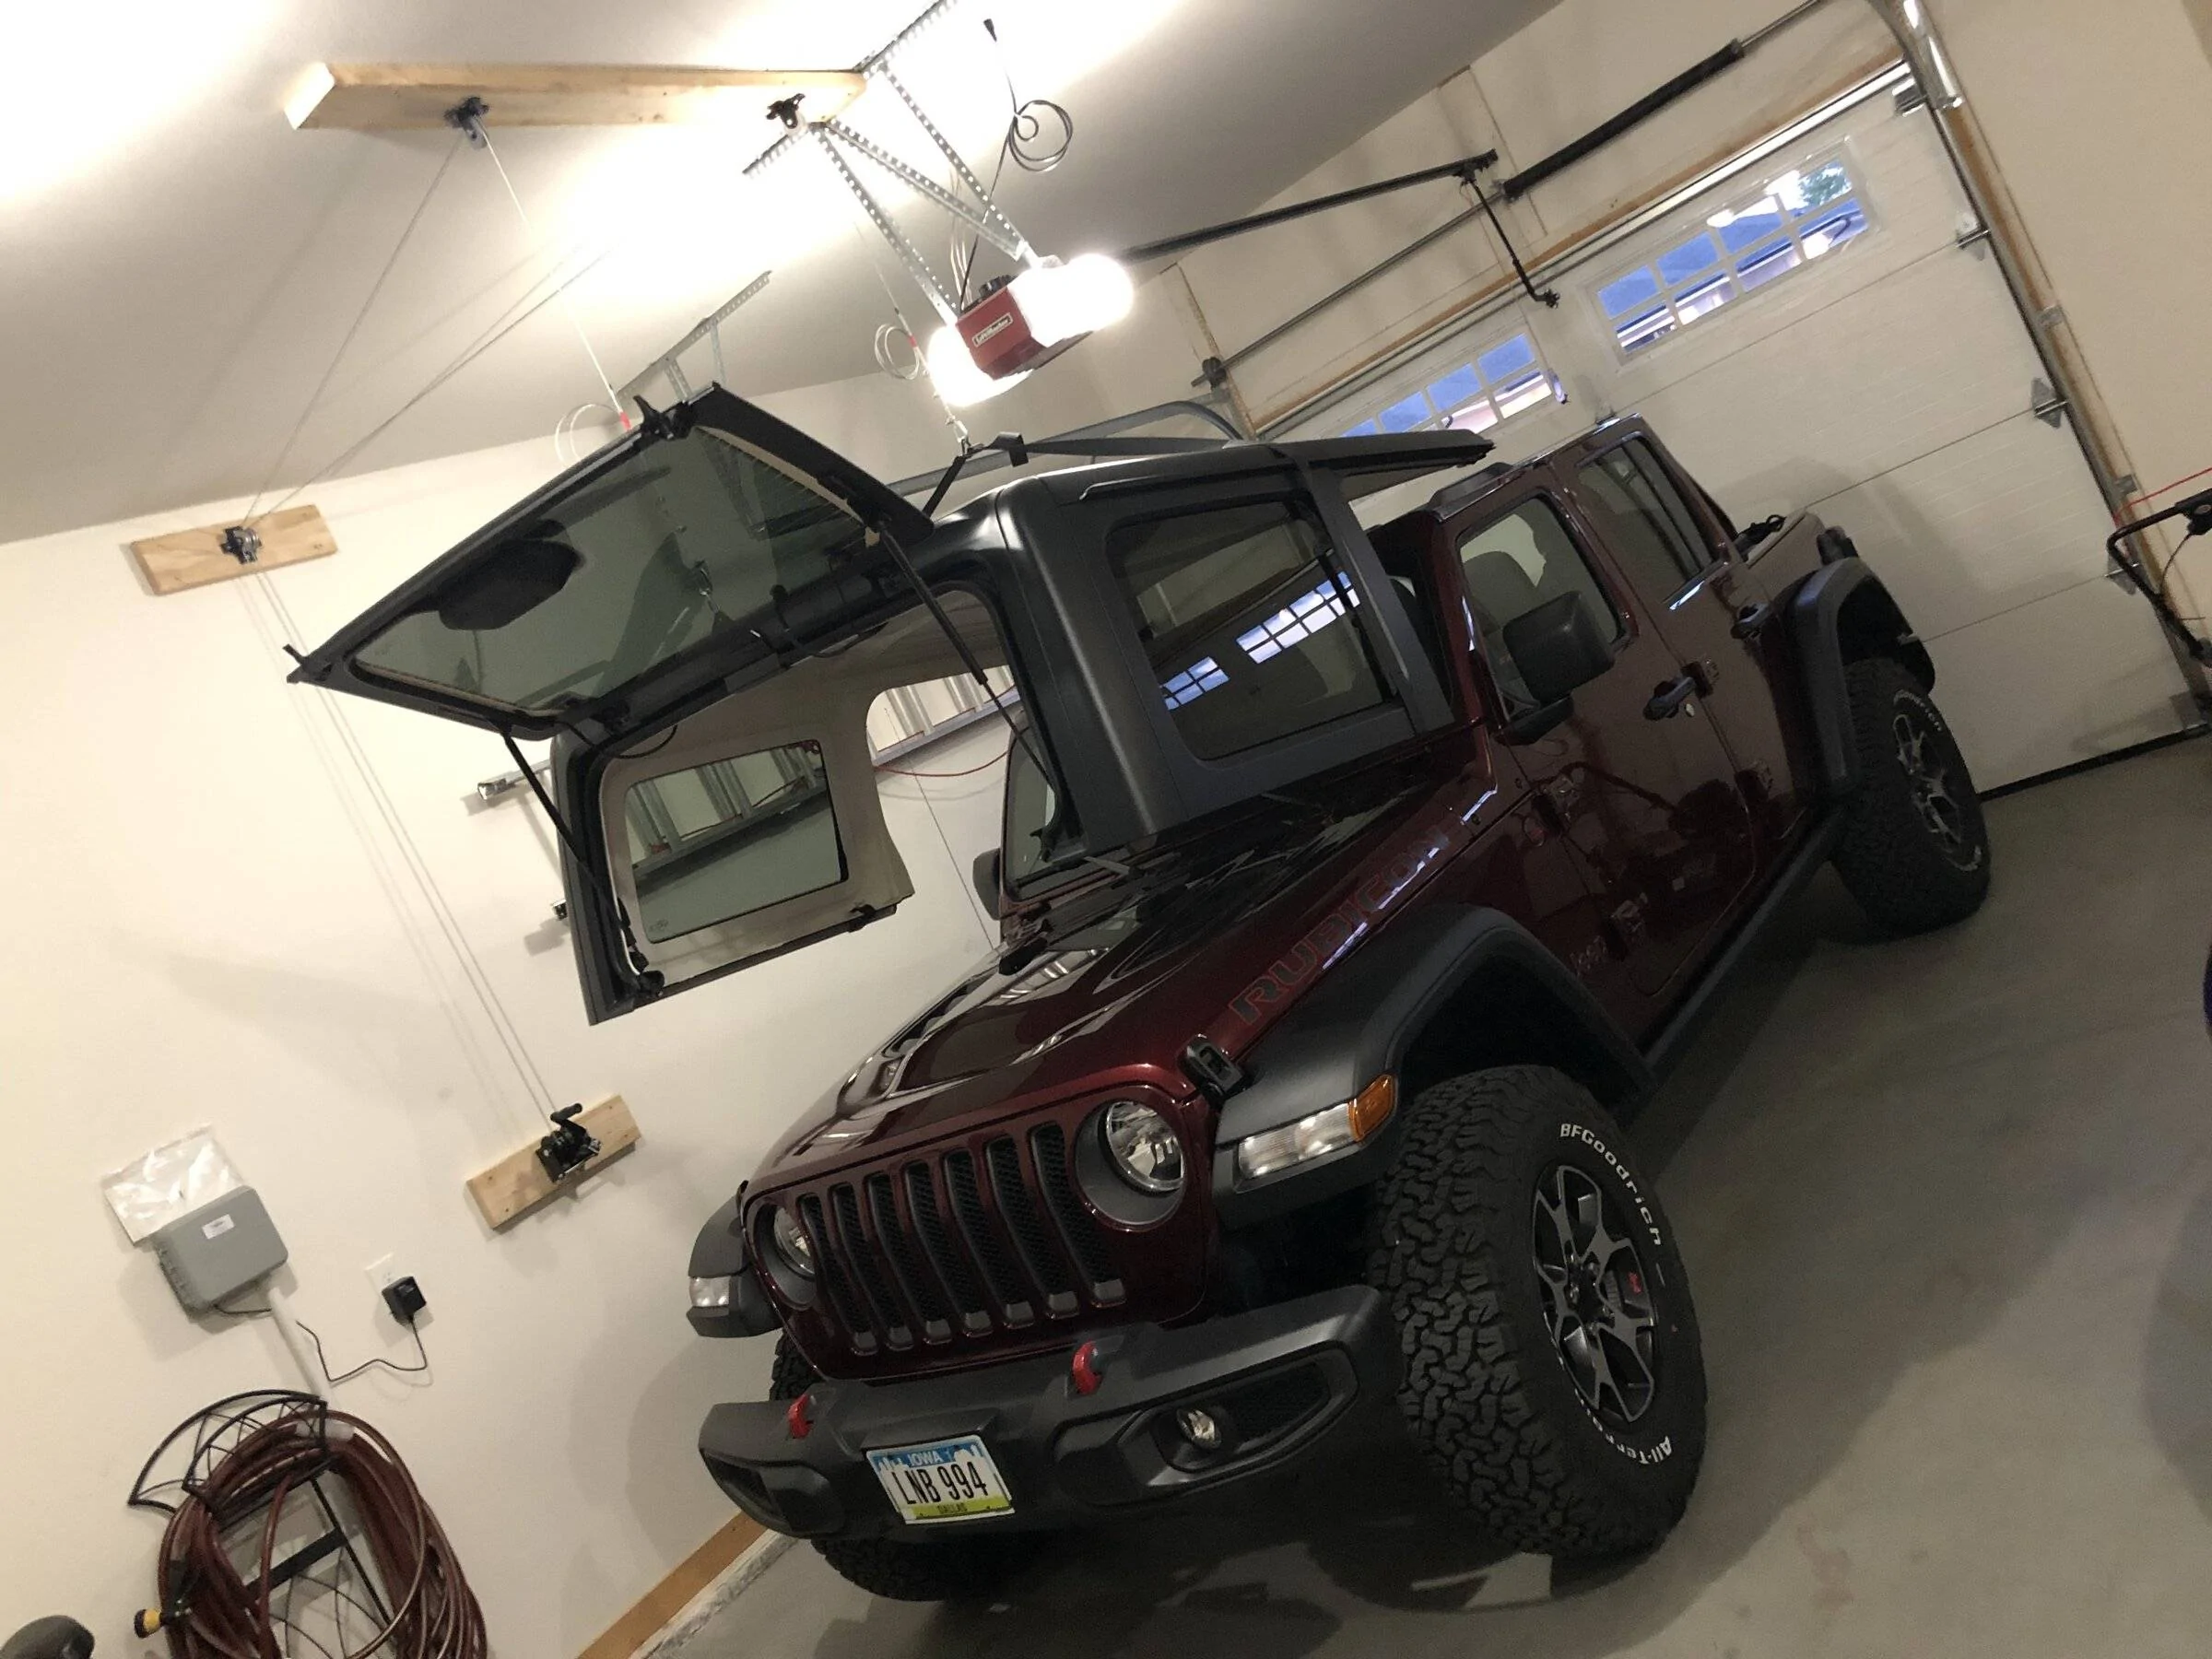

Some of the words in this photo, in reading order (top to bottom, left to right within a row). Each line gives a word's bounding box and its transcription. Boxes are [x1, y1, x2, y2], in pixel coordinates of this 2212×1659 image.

[1229, 824, 1452, 1025] RUBICON
[1560, 1123, 1661, 1245] BFGoodrich
[890, 1468, 941, 1505] LNB
[937, 1461, 989, 1500] 994
[908, 1450, 944, 1468] IOWA
